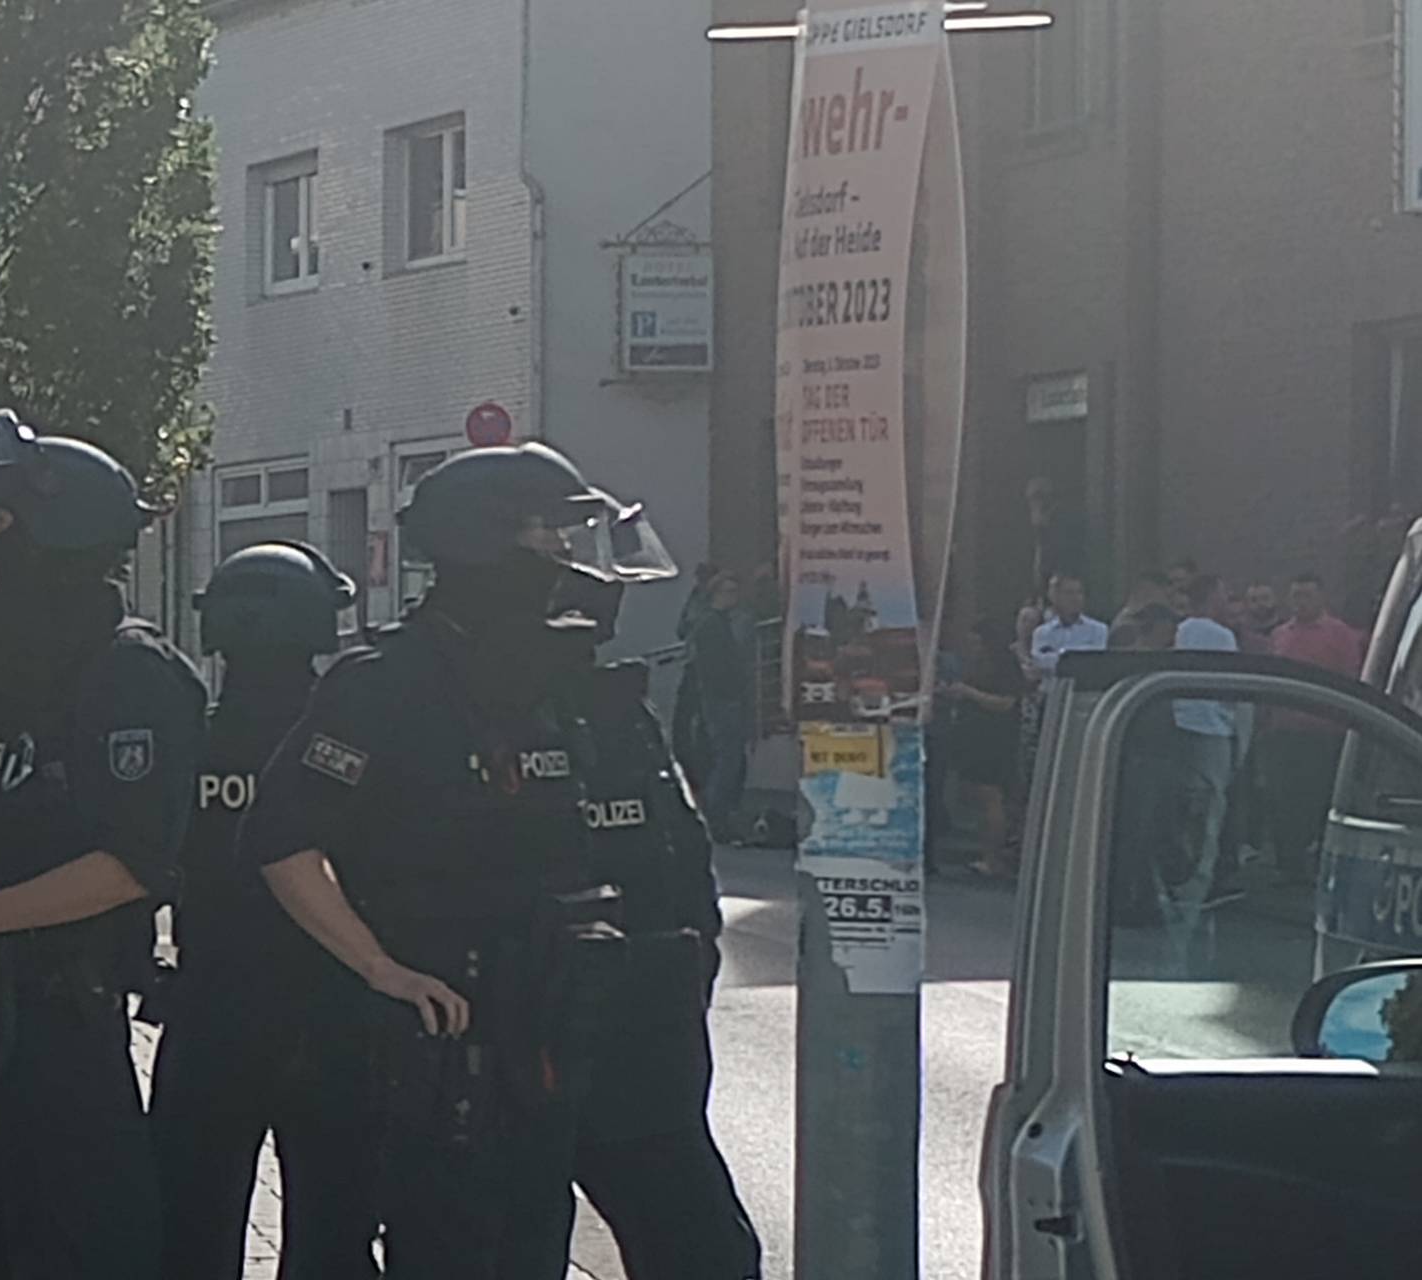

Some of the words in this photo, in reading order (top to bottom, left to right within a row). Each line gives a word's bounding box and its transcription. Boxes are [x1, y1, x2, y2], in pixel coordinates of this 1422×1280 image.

[807, 21, 841, 46] PPE
[843, 12, 928, 42] GIELSDORF
[835, 221, 882, 255] Heide
[842, 277, 892, 324] 2023
[822, 896, 891, 919] 26.5.
